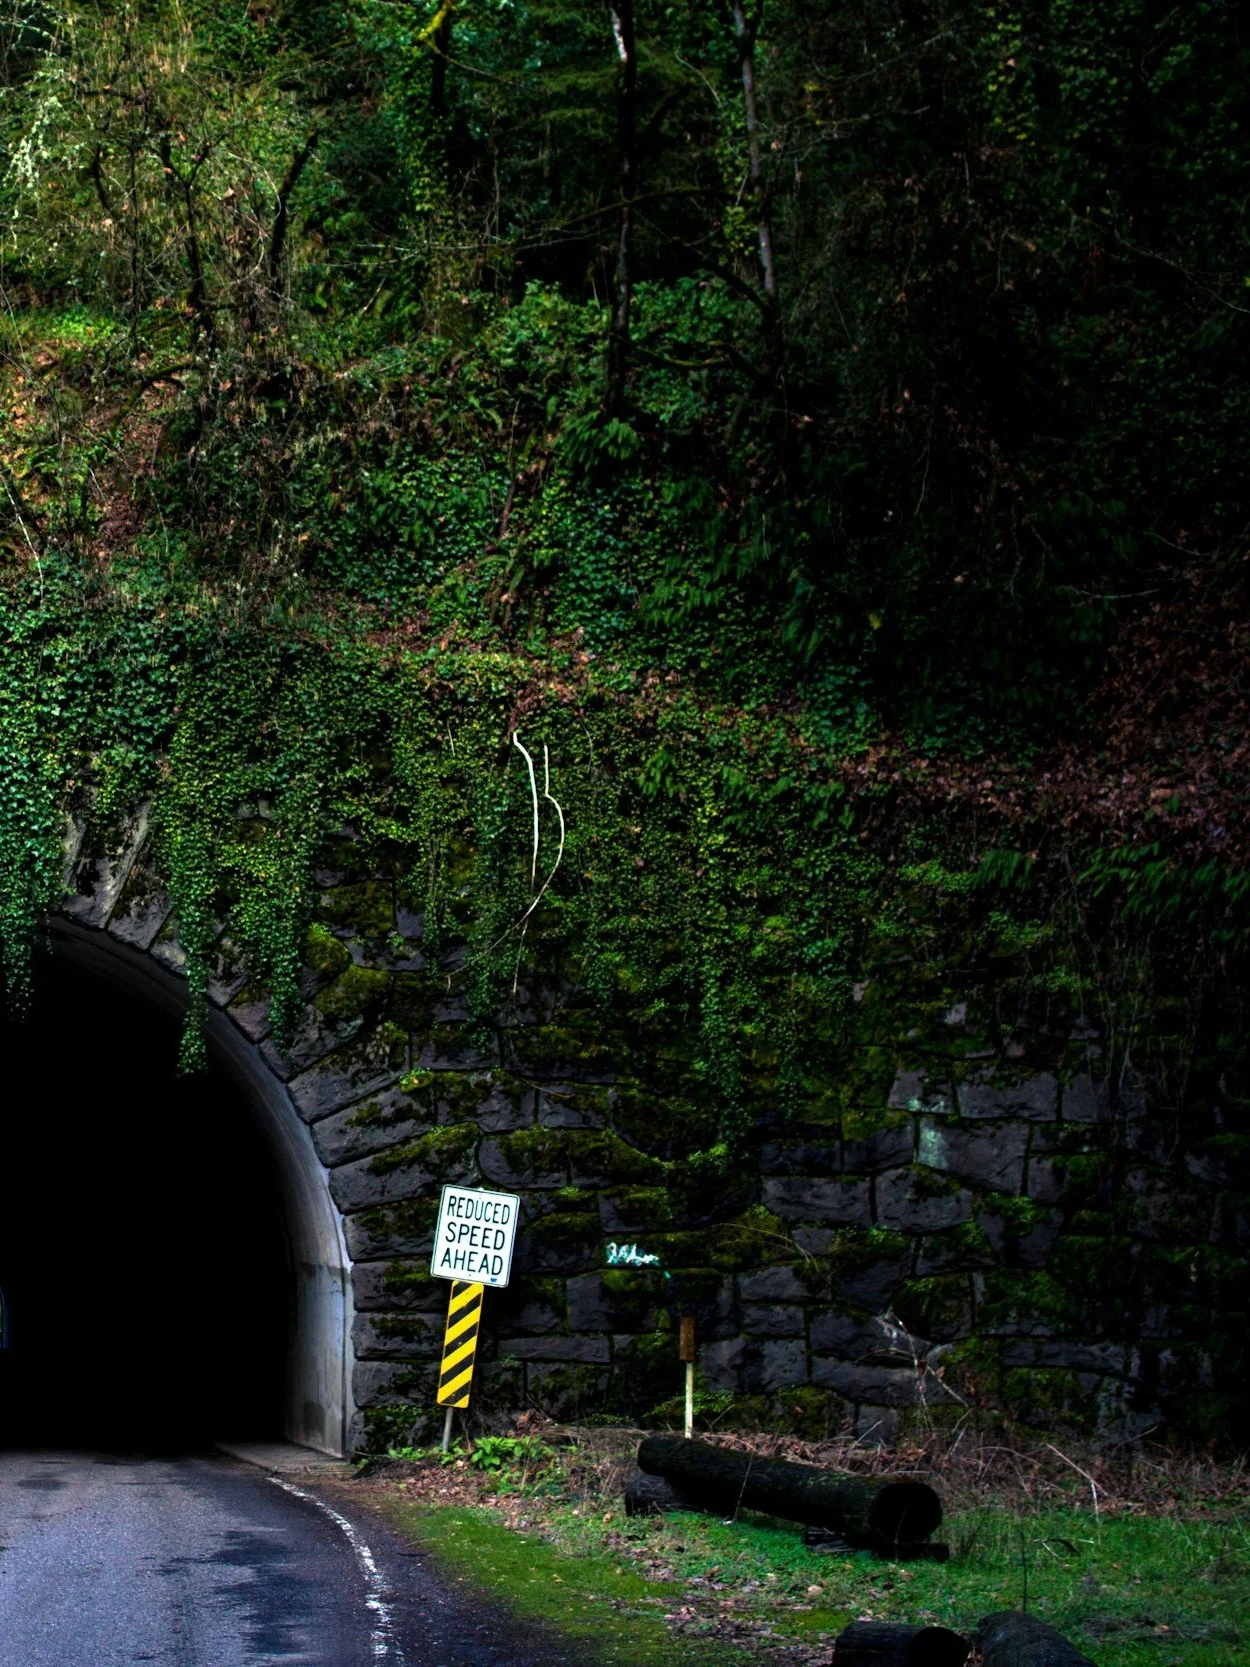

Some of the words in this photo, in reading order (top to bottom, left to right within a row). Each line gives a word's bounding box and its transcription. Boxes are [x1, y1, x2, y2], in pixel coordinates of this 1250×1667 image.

[447, 1196, 510, 1225] REDUCED
[445, 1222, 505, 1250] SPEED
[441, 1248, 504, 1275] AHEAD
